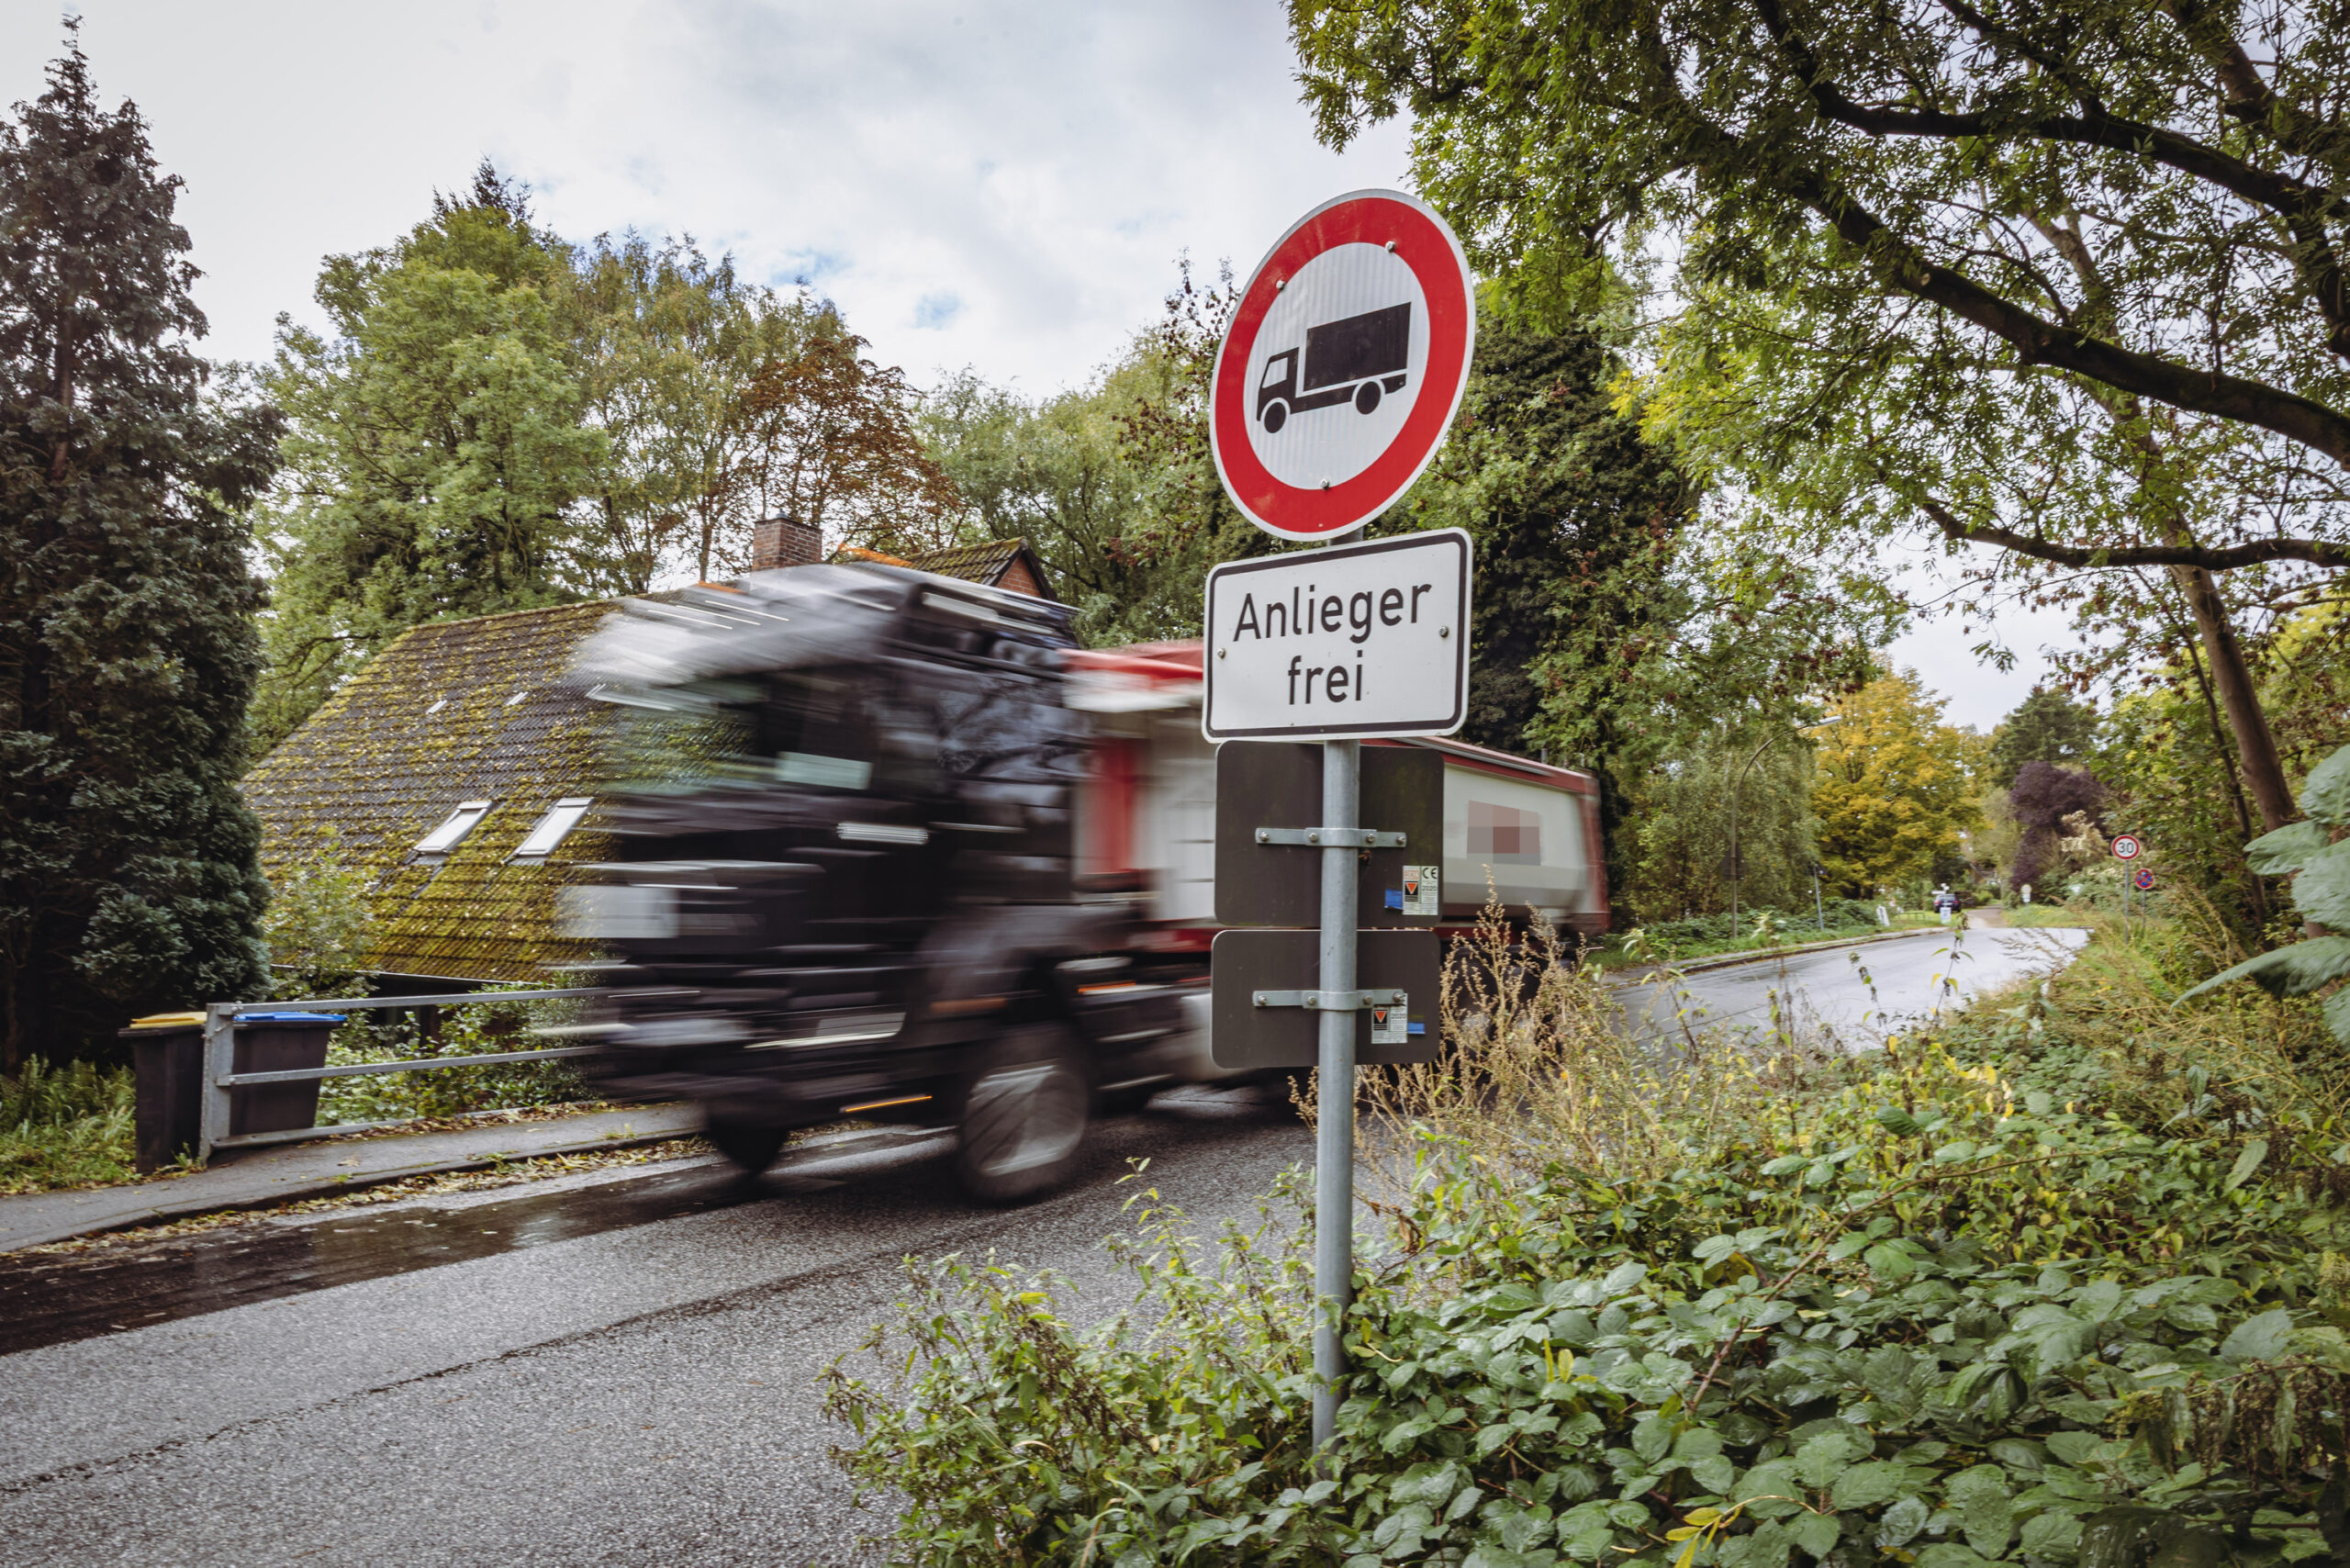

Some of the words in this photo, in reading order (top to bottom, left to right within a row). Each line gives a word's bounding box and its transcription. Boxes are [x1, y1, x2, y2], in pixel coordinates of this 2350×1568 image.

[1233, 584, 1432, 644] Anlieger
[1288, 650, 1363, 705] frei
[2118, 842, 2134, 853] 30
[1423, 868, 1438, 879] CE
